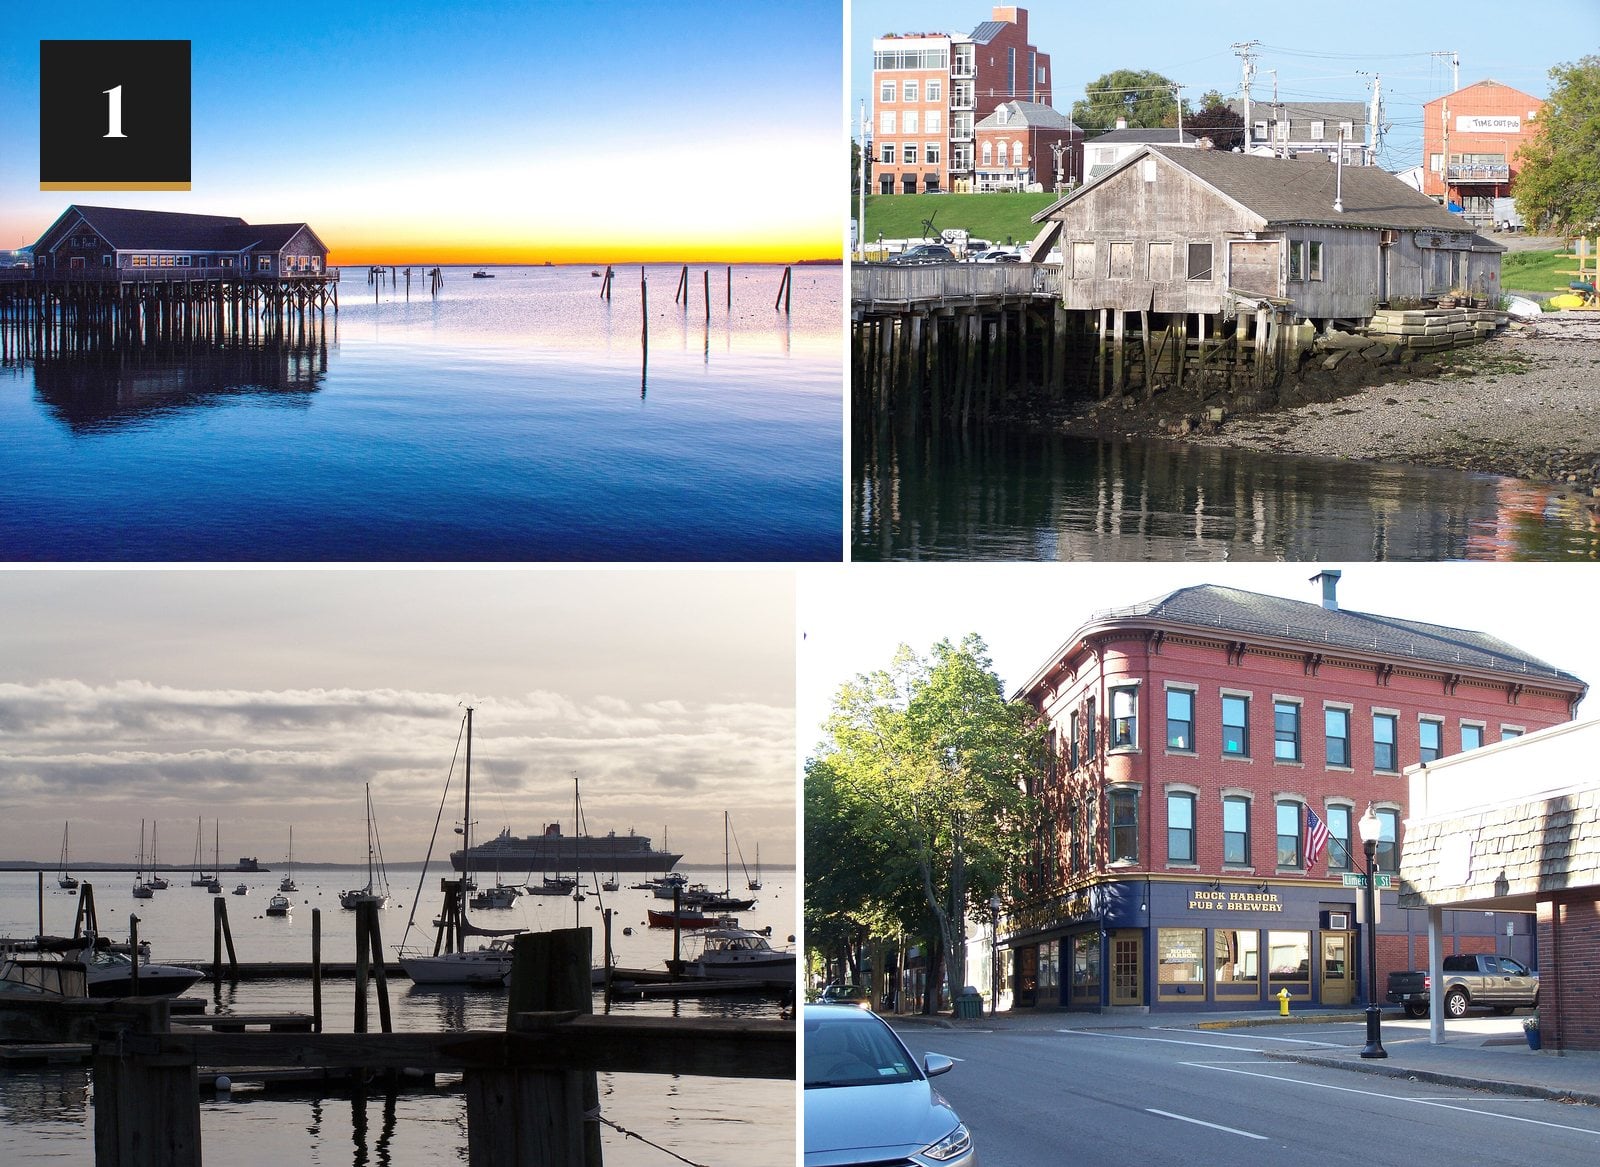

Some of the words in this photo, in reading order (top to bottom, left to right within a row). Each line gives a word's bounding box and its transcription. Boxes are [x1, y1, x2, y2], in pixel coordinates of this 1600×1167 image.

[1473, 119, 1492, 127] TIME
[1493, 119, 1506, 127] OUT
[1381, 876, 1389, 887] St
[1194, 891, 1226, 900] ROCK
[1229, 892, 1278, 902] HARBOR
[1189, 901, 1213, 910] PUB
[1216, 902, 1223, 910] &
[1227, 902, 1283, 912] BREWERY
